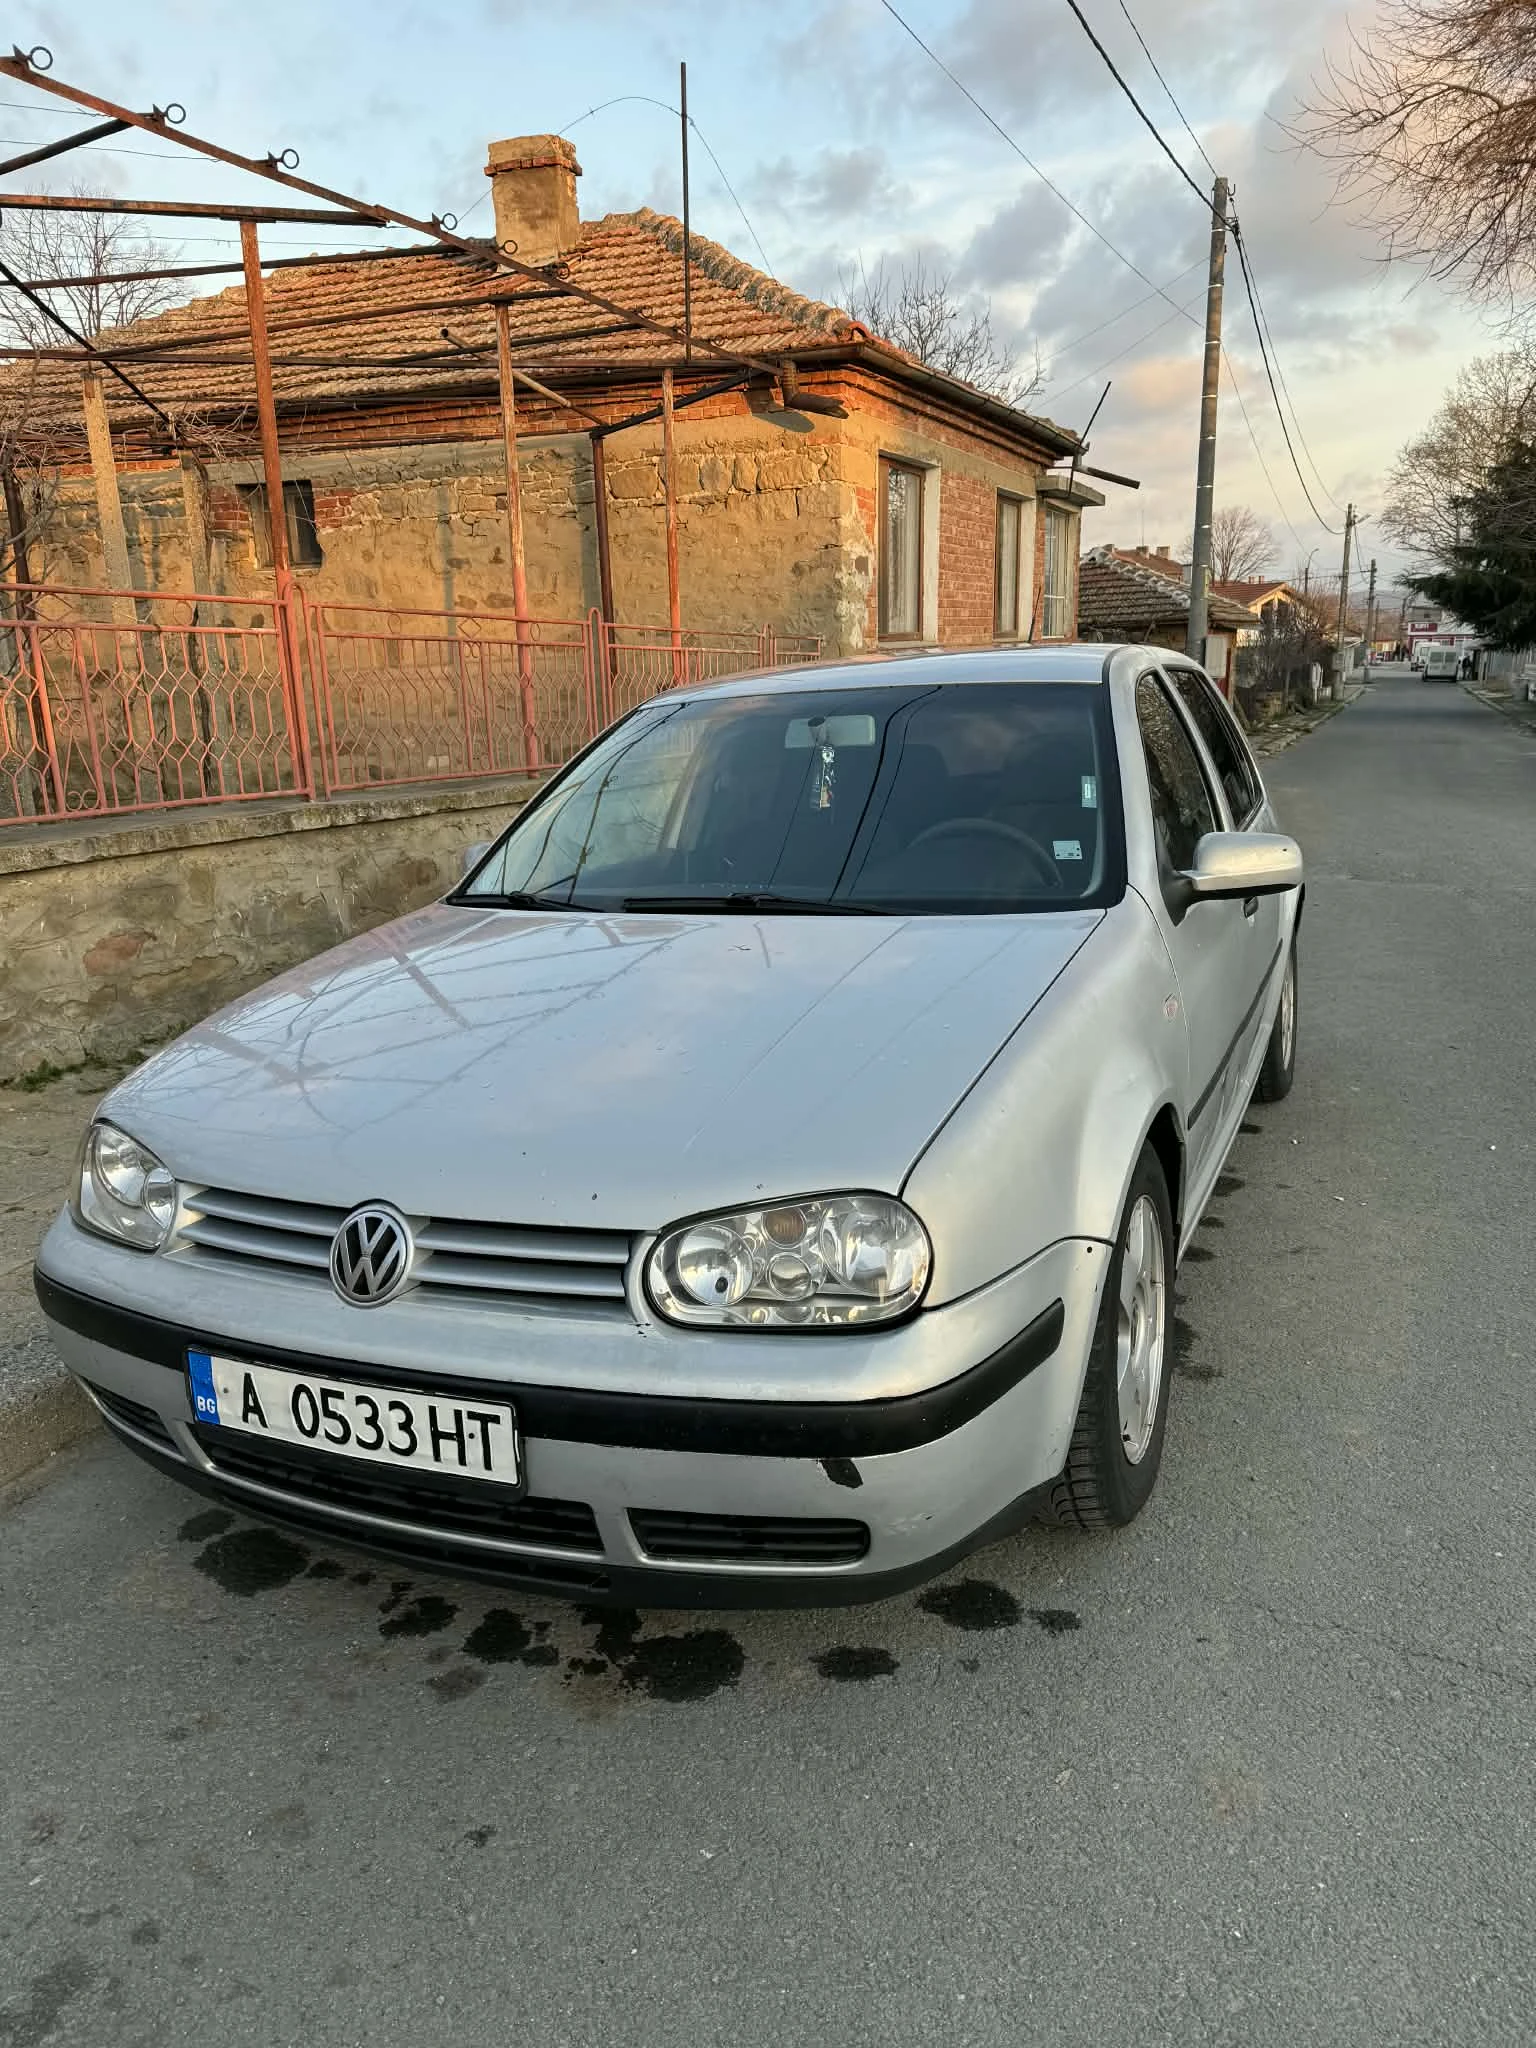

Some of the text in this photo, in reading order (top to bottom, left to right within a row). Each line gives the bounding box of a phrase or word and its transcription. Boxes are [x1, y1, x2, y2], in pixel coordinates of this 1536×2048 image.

[333, 1209, 405, 1300] VW
[197, 1395, 216, 1414] BG
[242, 1372, 501, 1472] A 0533 HT
